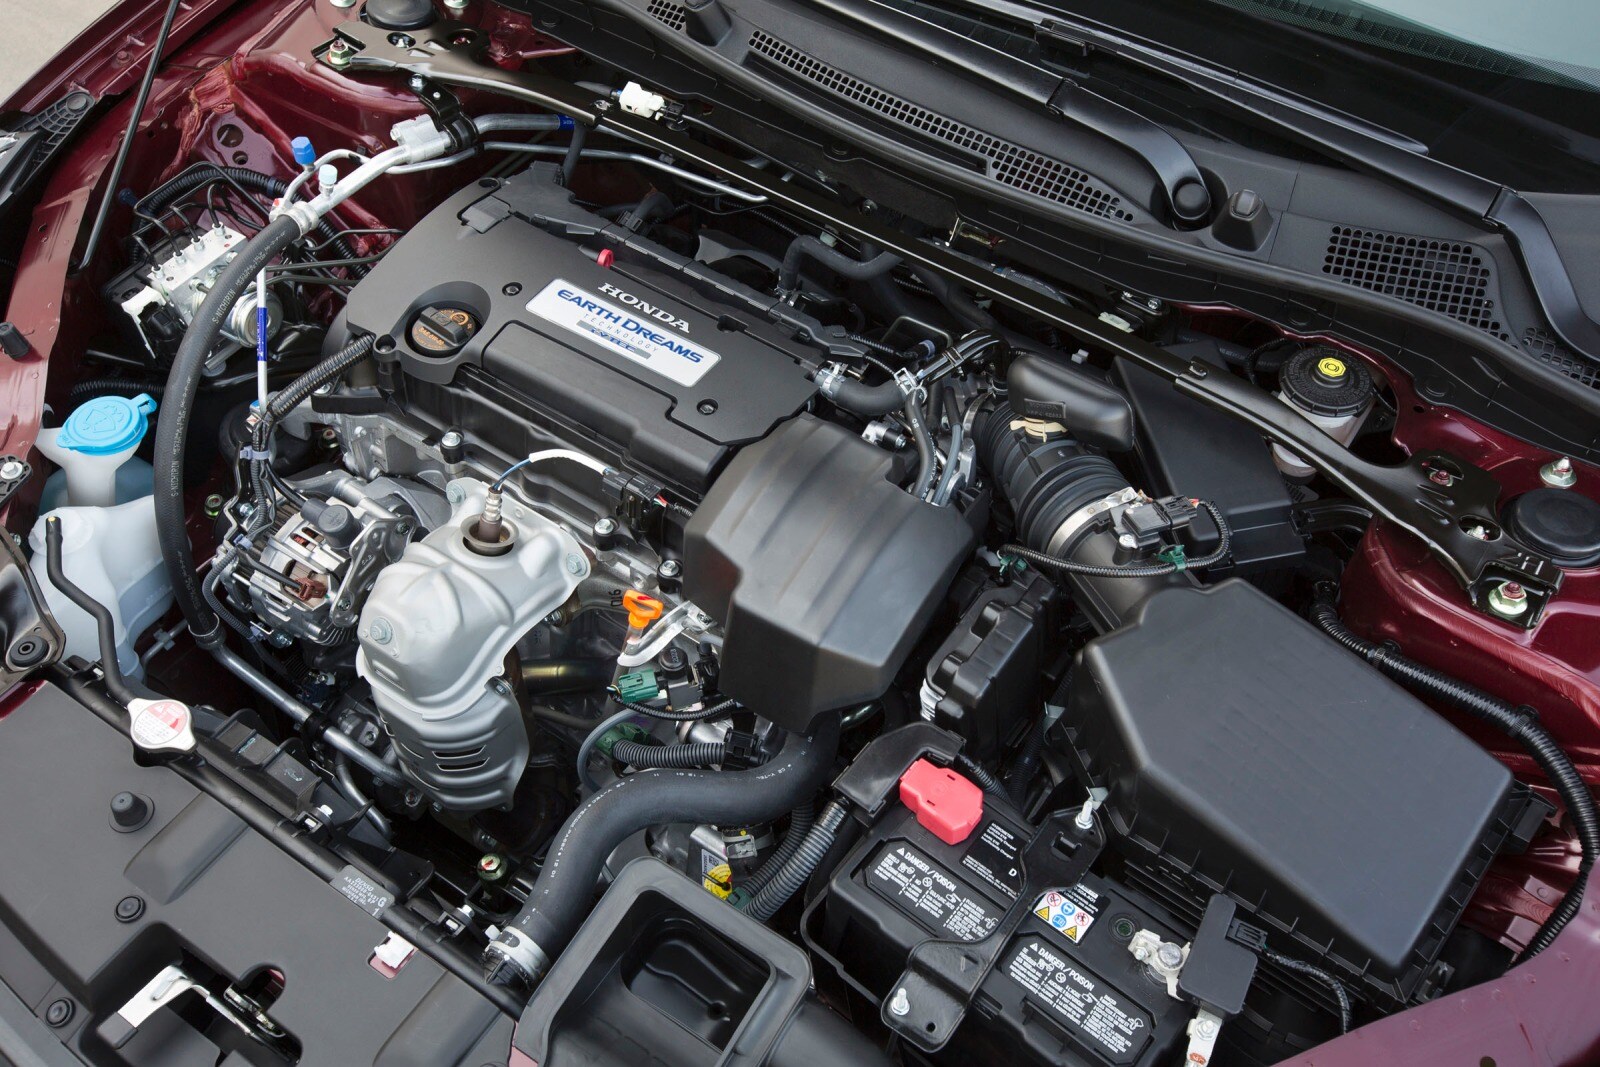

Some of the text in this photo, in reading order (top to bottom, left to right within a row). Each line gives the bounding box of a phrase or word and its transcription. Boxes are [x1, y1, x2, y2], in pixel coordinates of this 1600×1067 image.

[557, 289, 704, 364] EARTH DREAMS
[598, 282, 690, 333] HONDA
[583, 313, 659, 352] TECHNOLOGY
[354, 876, 374, 892] DENSO
[903, 851, 929, 873] DANGER
[932, 871, 956, 892] POISON
[1008, 868, 1017, 877] D
[372, 908, 380, 916] 1
[377, 896, 387, 907] G
[1037, 947, 1065, 970] DANGER
[1068, 968, 1095, 991] POISON
